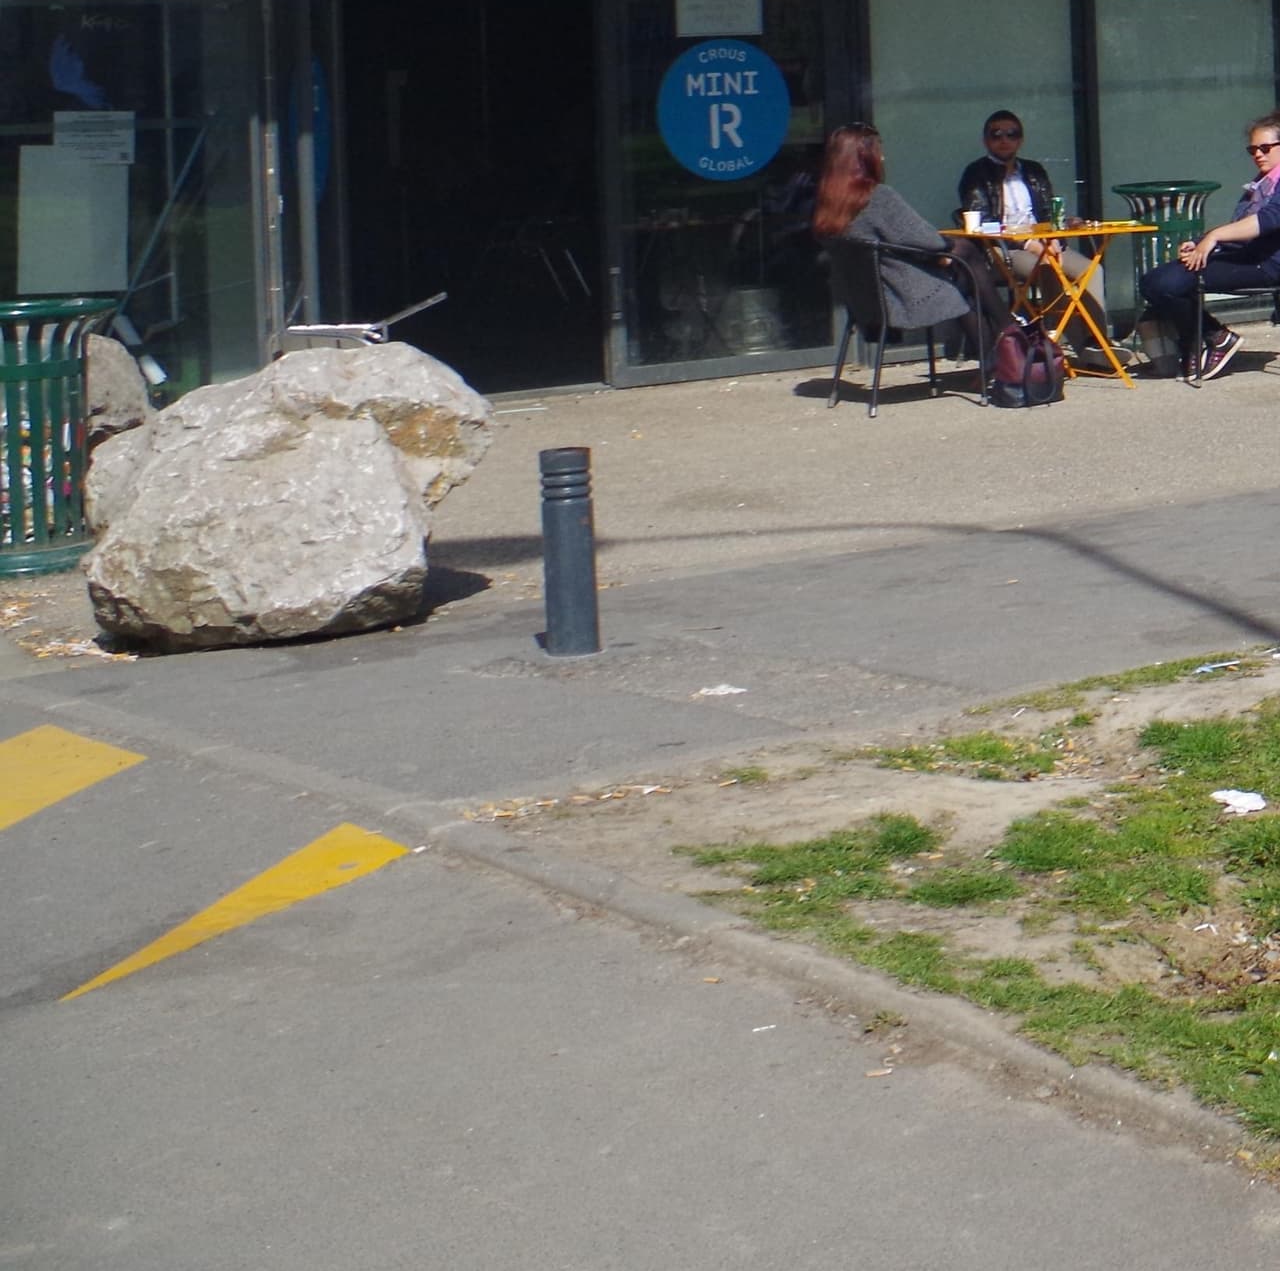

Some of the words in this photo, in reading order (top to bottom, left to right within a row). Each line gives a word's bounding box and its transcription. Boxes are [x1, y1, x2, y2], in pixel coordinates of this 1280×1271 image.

[698, 48, 747, 63] CROUS
[685, 70, 759, 97] MINI
[709, 102, 744, 149] R
[699, 156, 754, 172] GLOBAL
